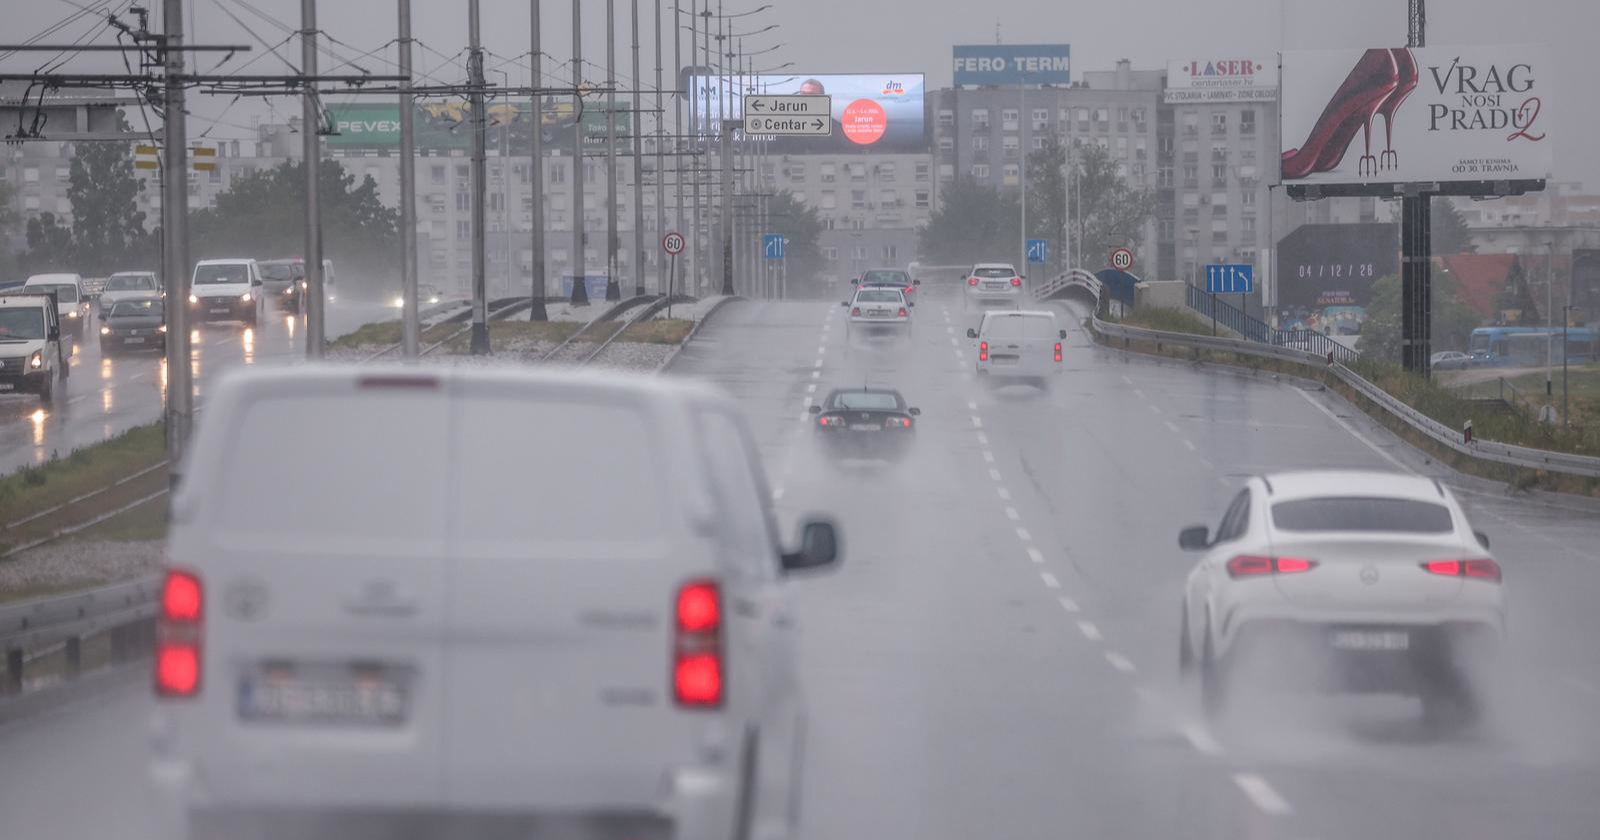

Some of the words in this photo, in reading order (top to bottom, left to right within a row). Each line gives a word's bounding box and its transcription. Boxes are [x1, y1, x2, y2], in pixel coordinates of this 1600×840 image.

[953, 57, 1006, 72] FERO
[1014, 56, 1069, 71] TERM
[1191, 60, 1254, 76] LASER
[1428, 57, 1535, 95] VRAG
[886, 80, 902, 90] dm
[770, 100, 808, 112] Jarun
[1462, 95, 1501, 107] NOSI
[764, 119, 807, 130] Centar
[1428, 103, 1531, 131] PRADU
[1506, 97, 1546, 141] 2
[336, 120, 401, 132] PEVEX
[1452, 164, 1465, 173] OD
[1467, 164, 1479, 173] 30.
[1482, 163, 1519, 173] TRAVNJA
[667, 238, 680, 250] 60
[1115, 254, 1128, 265] 60
[1299, 265, 1311, 277] 04
[1331, 264, 1341, 276] 12
[1360, 264, 1373, 276] 26
